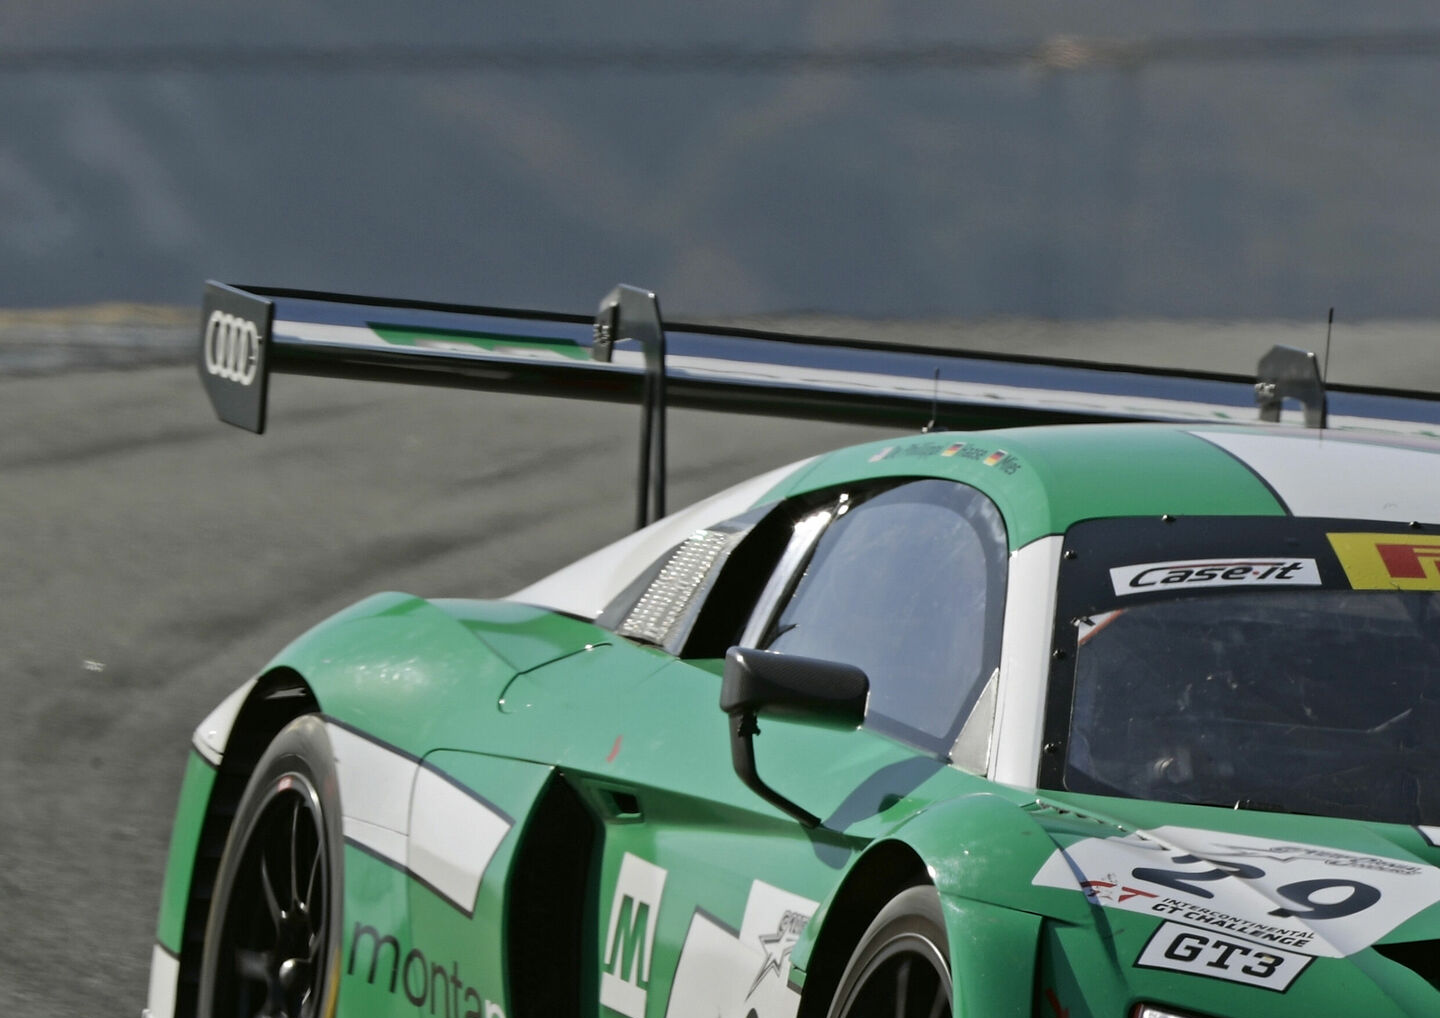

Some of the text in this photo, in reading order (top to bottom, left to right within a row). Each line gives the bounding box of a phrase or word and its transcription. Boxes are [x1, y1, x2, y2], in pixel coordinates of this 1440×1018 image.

[1132, 854, 1382, 920] 29
[1151, 902, 1312, 948] GT CHALLENGE
[1162, 898, 1316, 940] INTERCONTINENTAL
[1164, 932, 1285, 979] GT3
